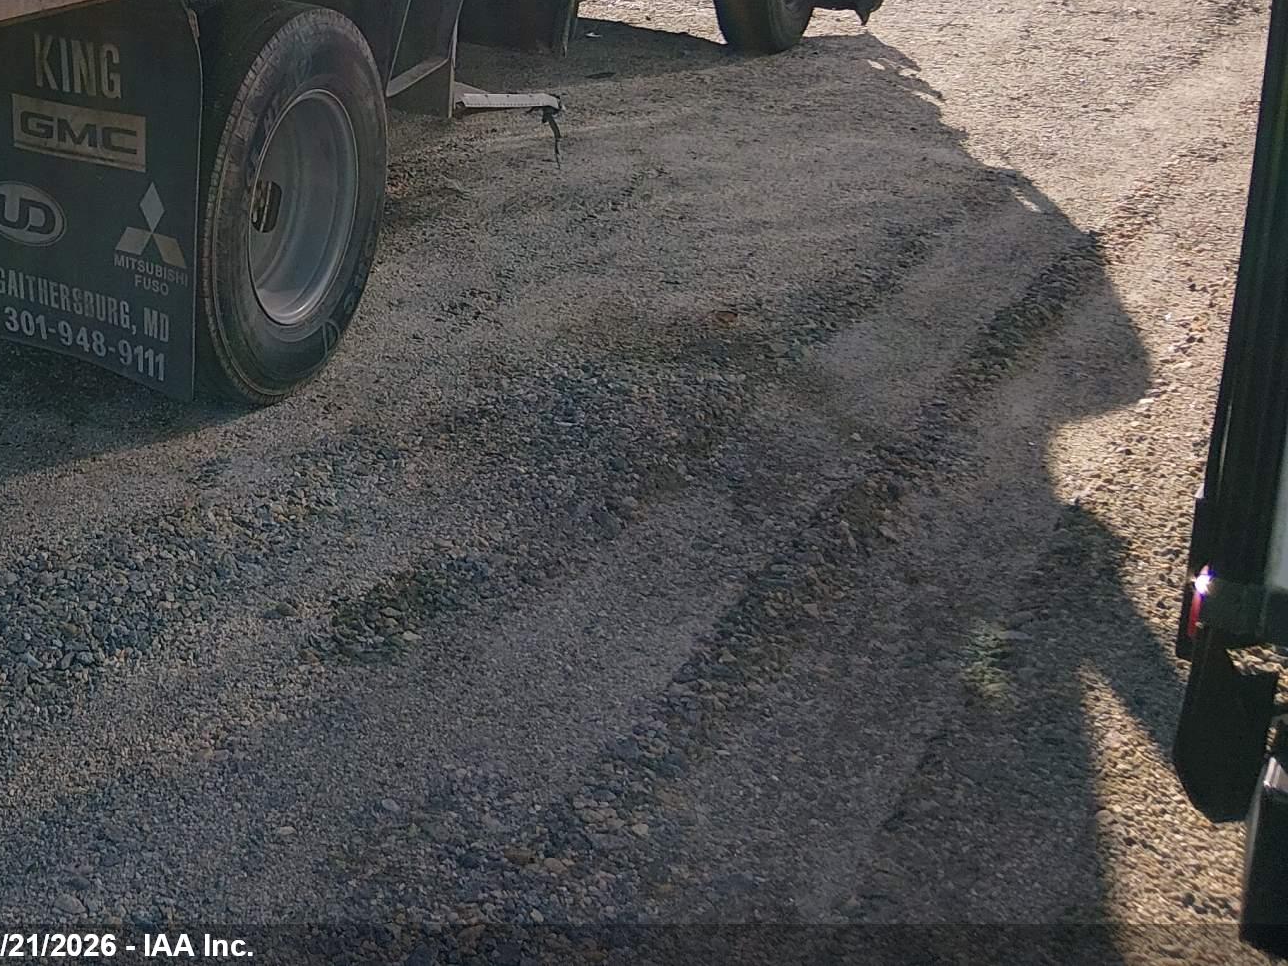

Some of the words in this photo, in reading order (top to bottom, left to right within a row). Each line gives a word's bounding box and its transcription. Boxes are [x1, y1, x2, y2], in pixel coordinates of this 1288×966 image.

[34, 33, 122, 99] KING
[19, 110, 138, 155] GMC
[114, 253, 189, 287] MITSUBISHI
[134, 274, 170, 297] FUSO
[4, 306, 165, 383] 301-948-9111
[143, 305, 170, 344] MD
